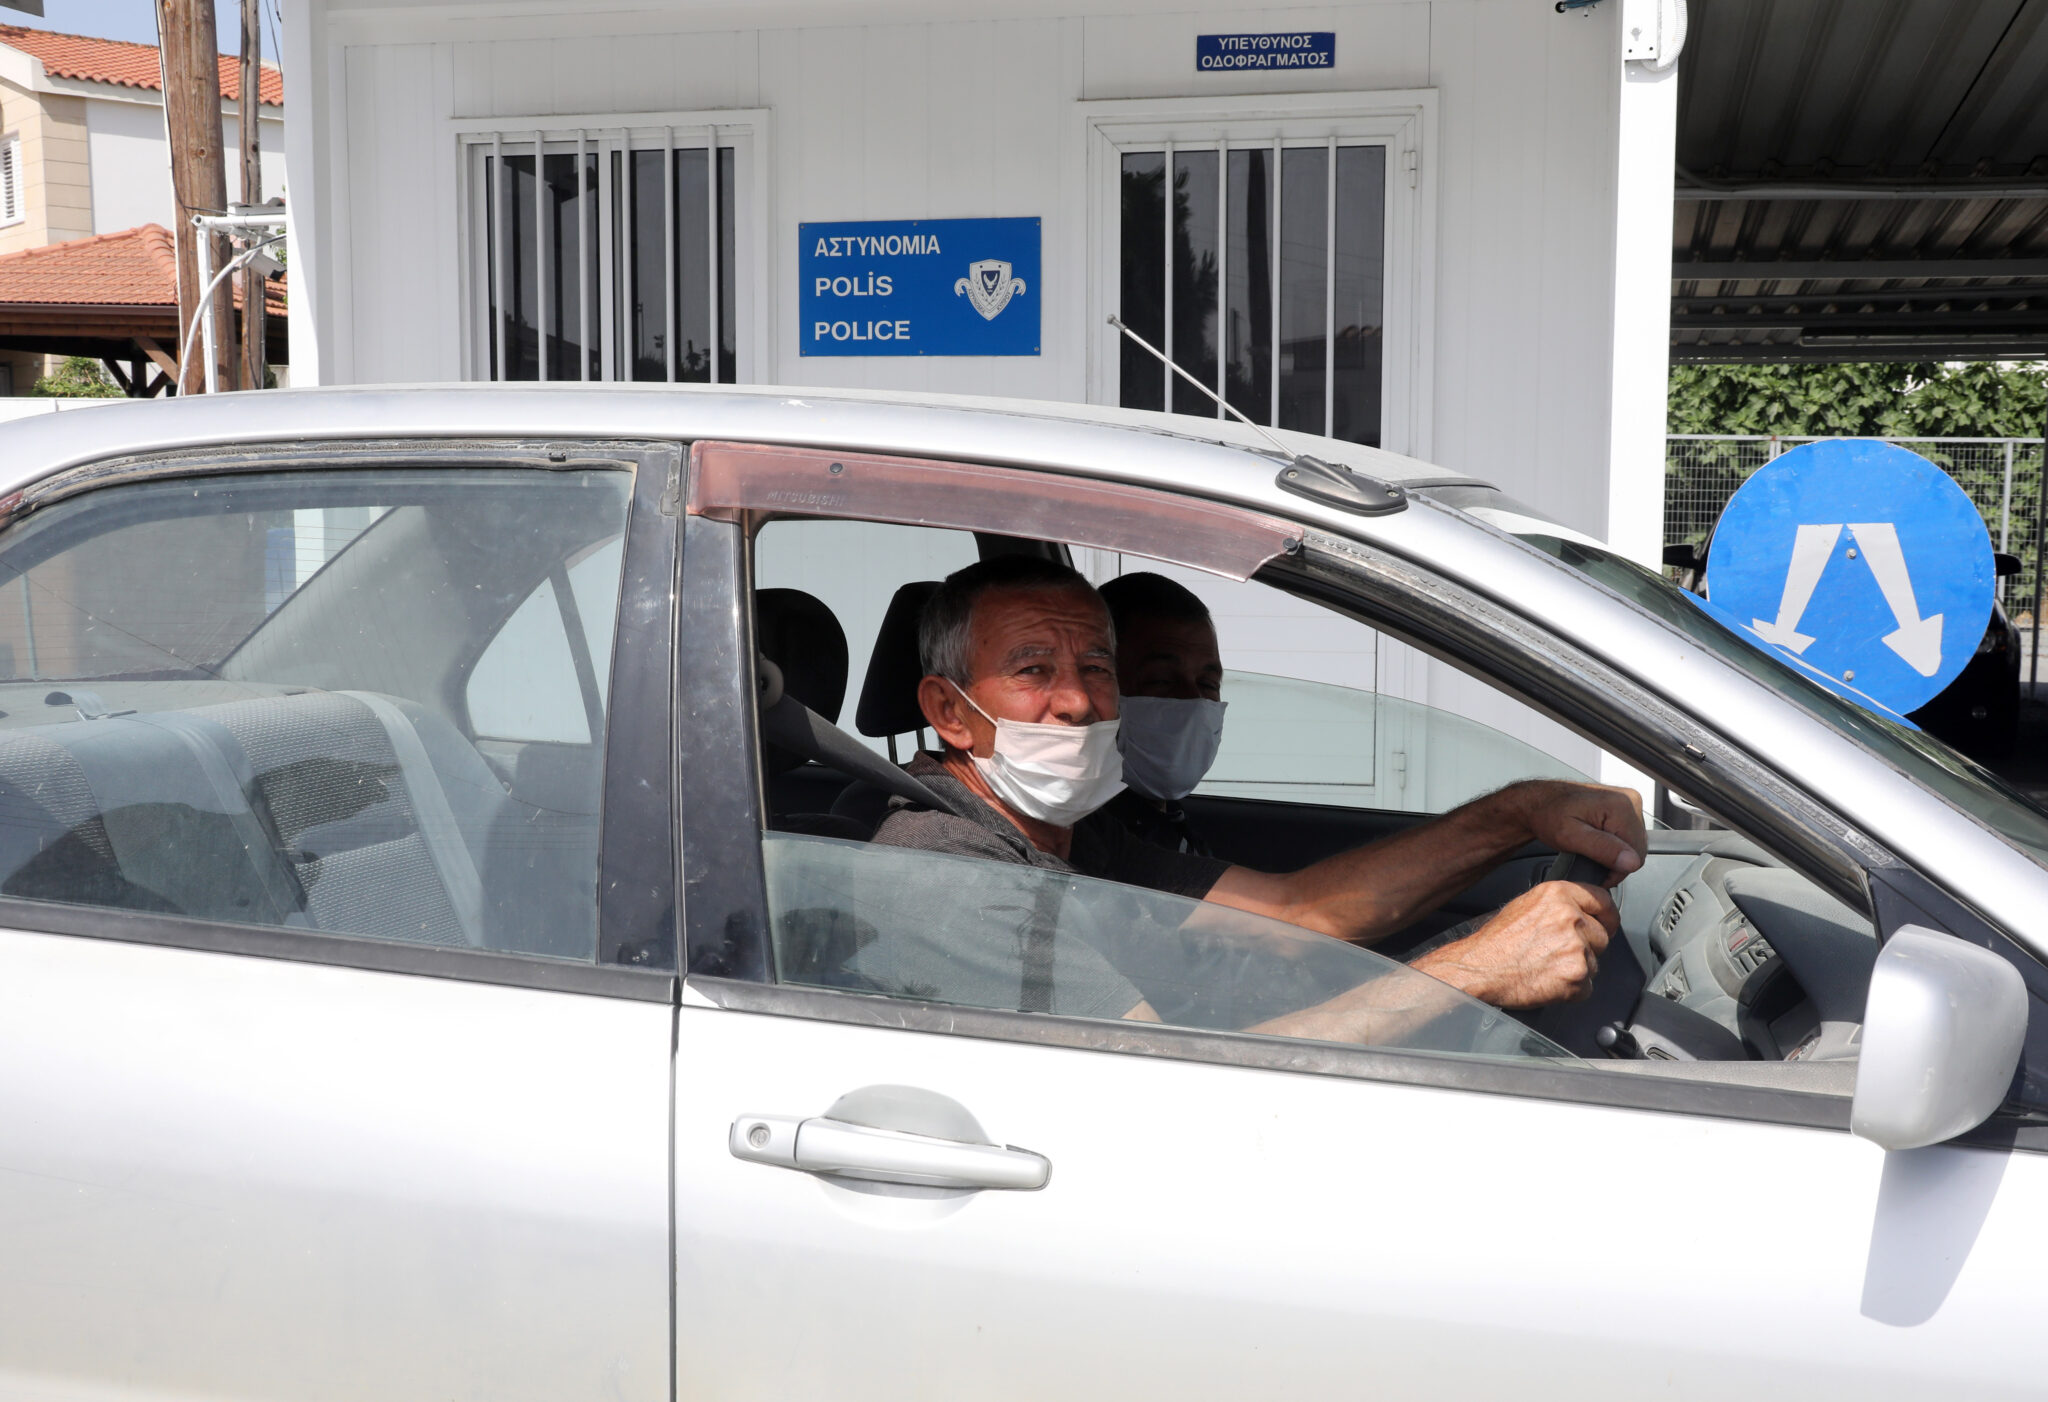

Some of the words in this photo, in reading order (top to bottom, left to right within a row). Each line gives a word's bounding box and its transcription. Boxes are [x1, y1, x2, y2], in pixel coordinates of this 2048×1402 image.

[1218, 35, 1312, 50] ΥΠΕΥΘΥΝΟΣ
[1202, 52, 1328, 68] ΟΔΟΦΡΑΓΜΑΤΟΣ
[815, 235, 941, 257] ΑΣΤΥΝΟΜΙΑ
[816, 320, 910, 341] POLICE
